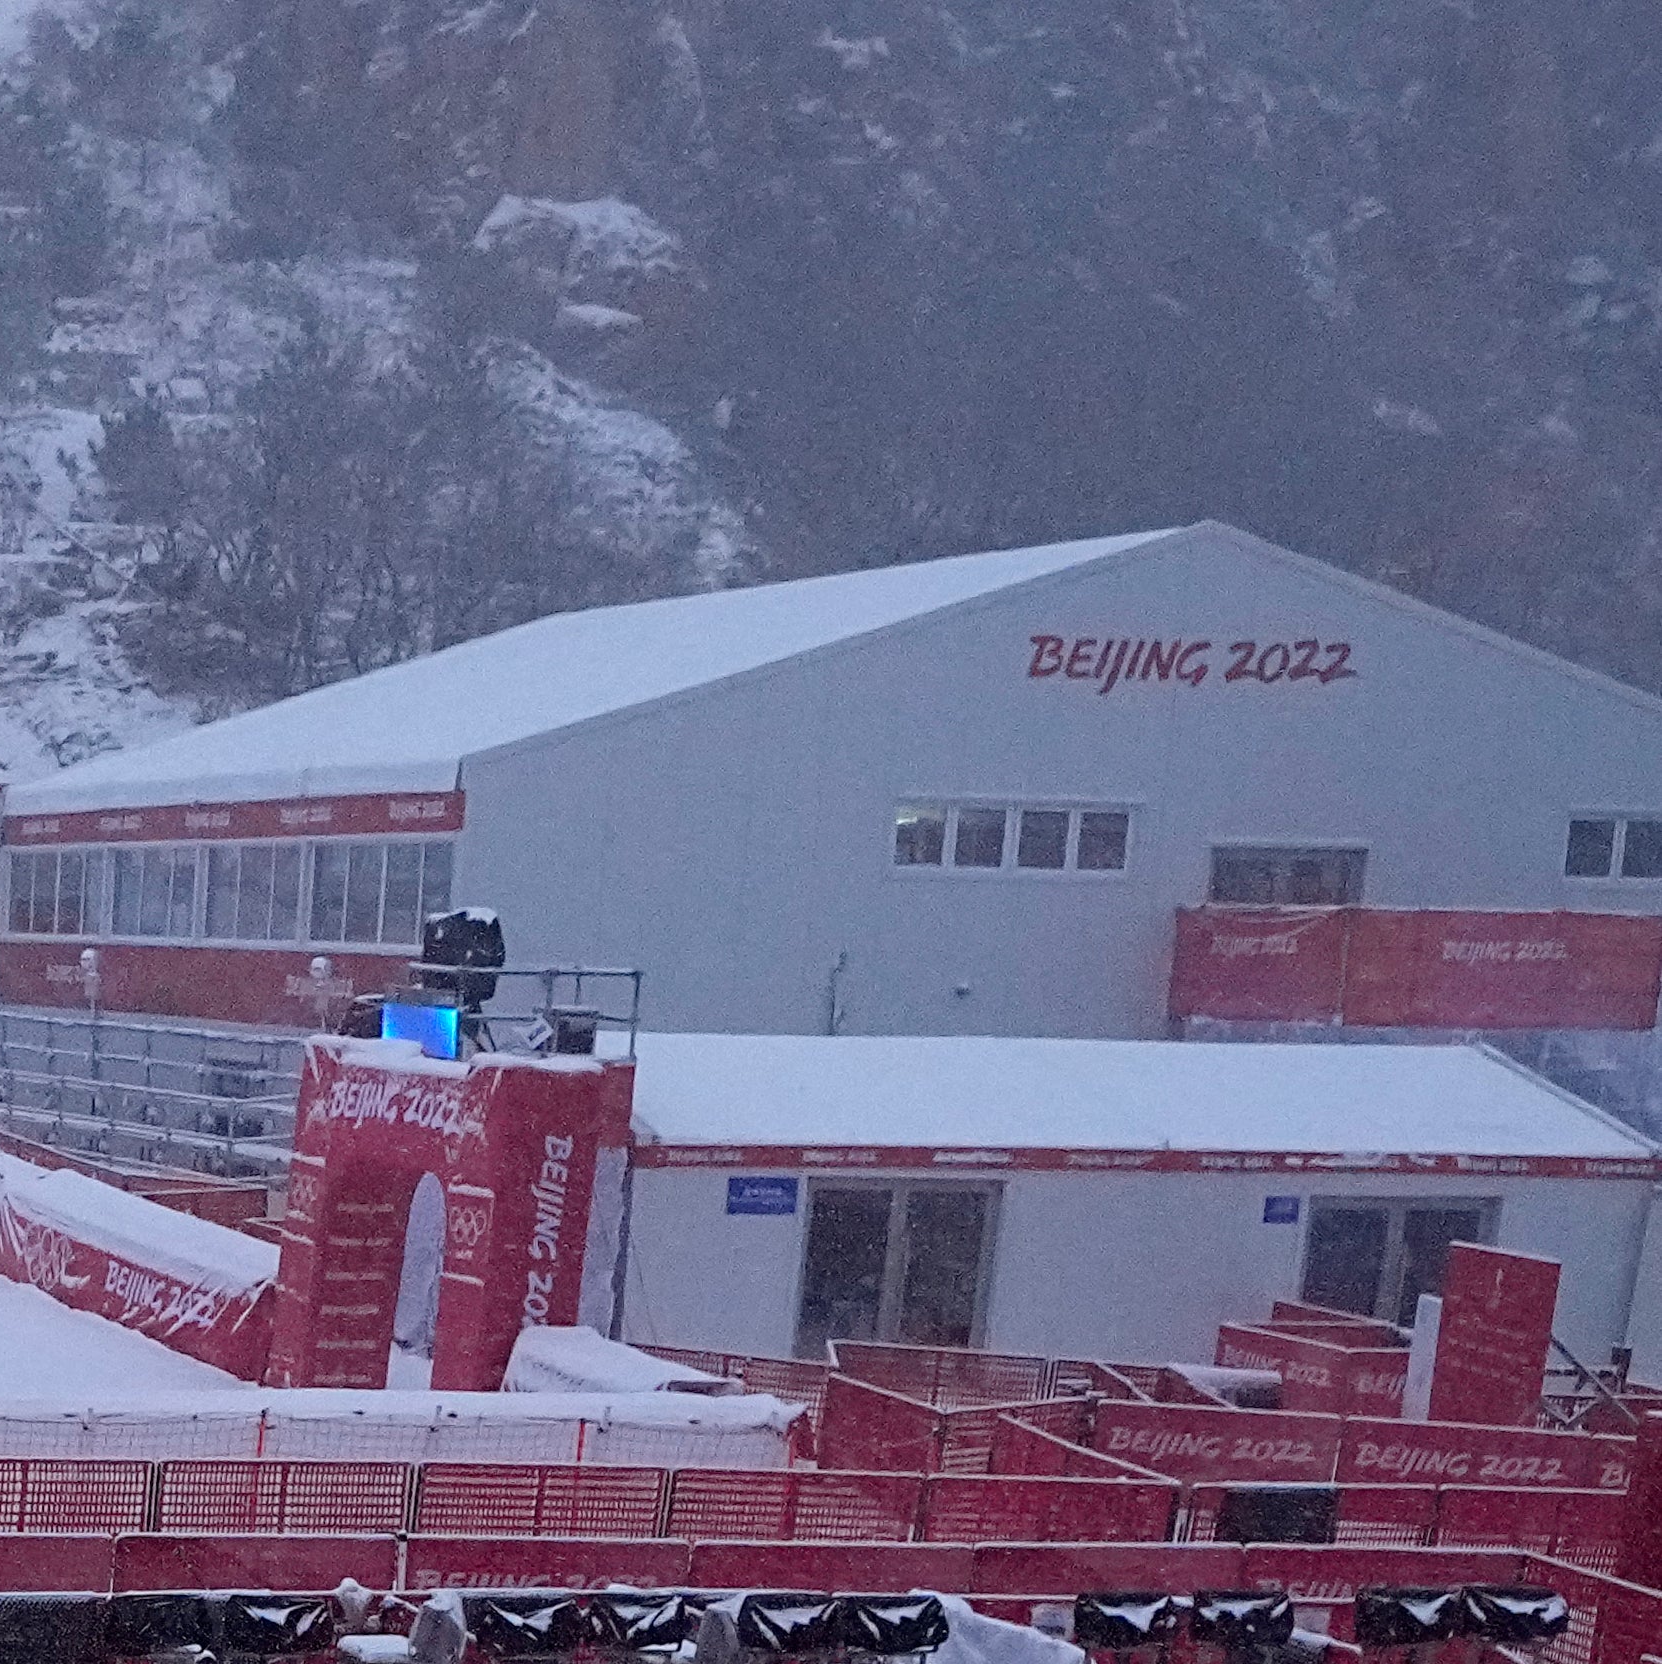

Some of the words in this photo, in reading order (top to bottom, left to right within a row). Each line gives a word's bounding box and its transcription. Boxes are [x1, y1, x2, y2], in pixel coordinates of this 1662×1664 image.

[1029, 634, 1212, 695] BEIJING
[1225, 639, 1358, 684] 2022
[328, 1079, 400, 1129] BEIJING
[403, 1087, 465, 1137] 2022
[527, 1134, 574, 1262] BEIJING
[104, 1259, 166, 1318] BEIJING
[522, 1271, 554, 1326] 20
[1108, 1426, 1221, 1462] BEIJING
[1231, 1437, 1316, 1463] 2022
[1354, 1441, 1472, 1480] BEIJING
[1475, 1456, 1569, 1483] 2022
